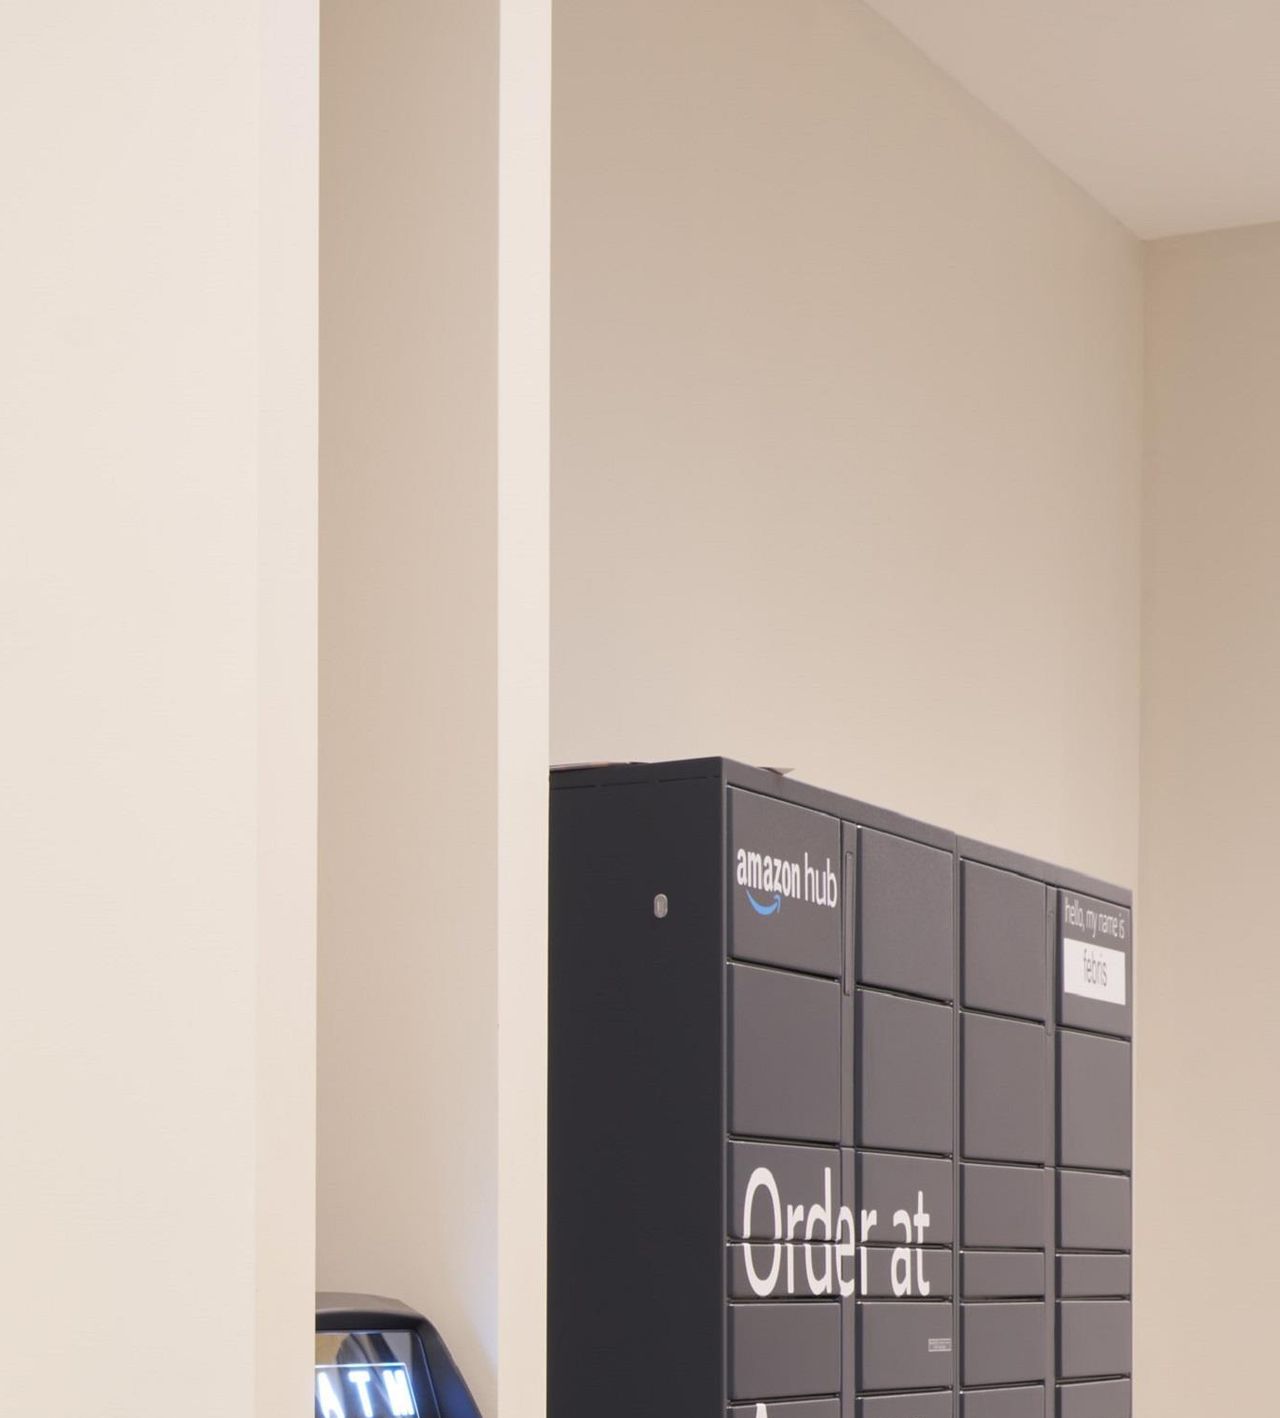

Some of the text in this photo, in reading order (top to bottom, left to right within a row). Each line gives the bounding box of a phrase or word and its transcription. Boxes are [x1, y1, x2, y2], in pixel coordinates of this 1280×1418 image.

[737, 848, 838, 908] amazon hub
[1086, 909, 1098, 938] my
[1099, 913, 1118, 937] name
[1119, 912, 1126, 939] is
[742, 1166, 931, 1297] Order at
